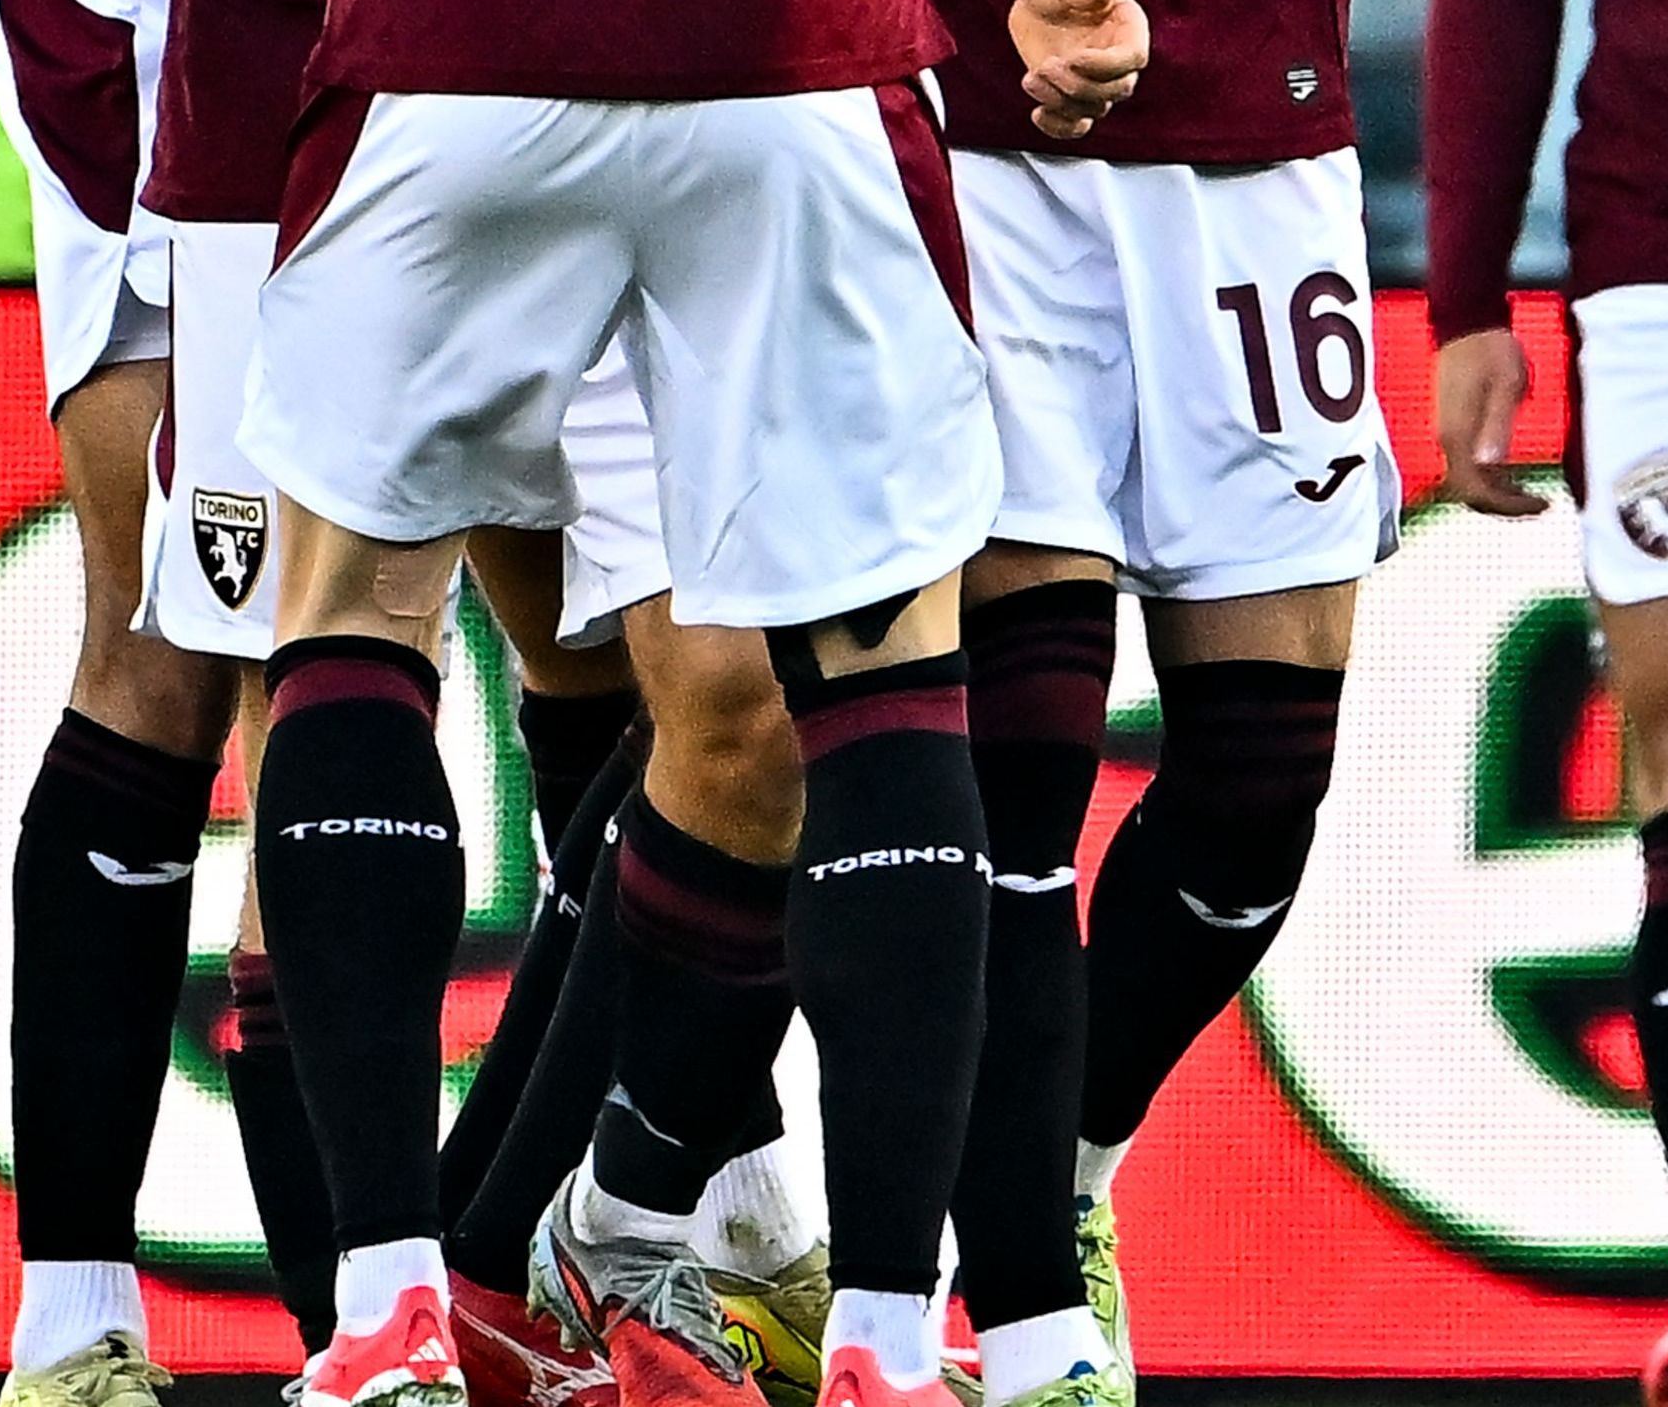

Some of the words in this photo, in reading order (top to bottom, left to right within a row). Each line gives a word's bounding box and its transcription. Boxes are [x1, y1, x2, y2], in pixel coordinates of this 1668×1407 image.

[1215, 269, 1366, 434] 16
[198, 497, 259, 523] TORINO
[236, 530, 260, 549] FC
[278, 817, 449, 841] TORINO
[807, 846, 966, 881] TORINO
